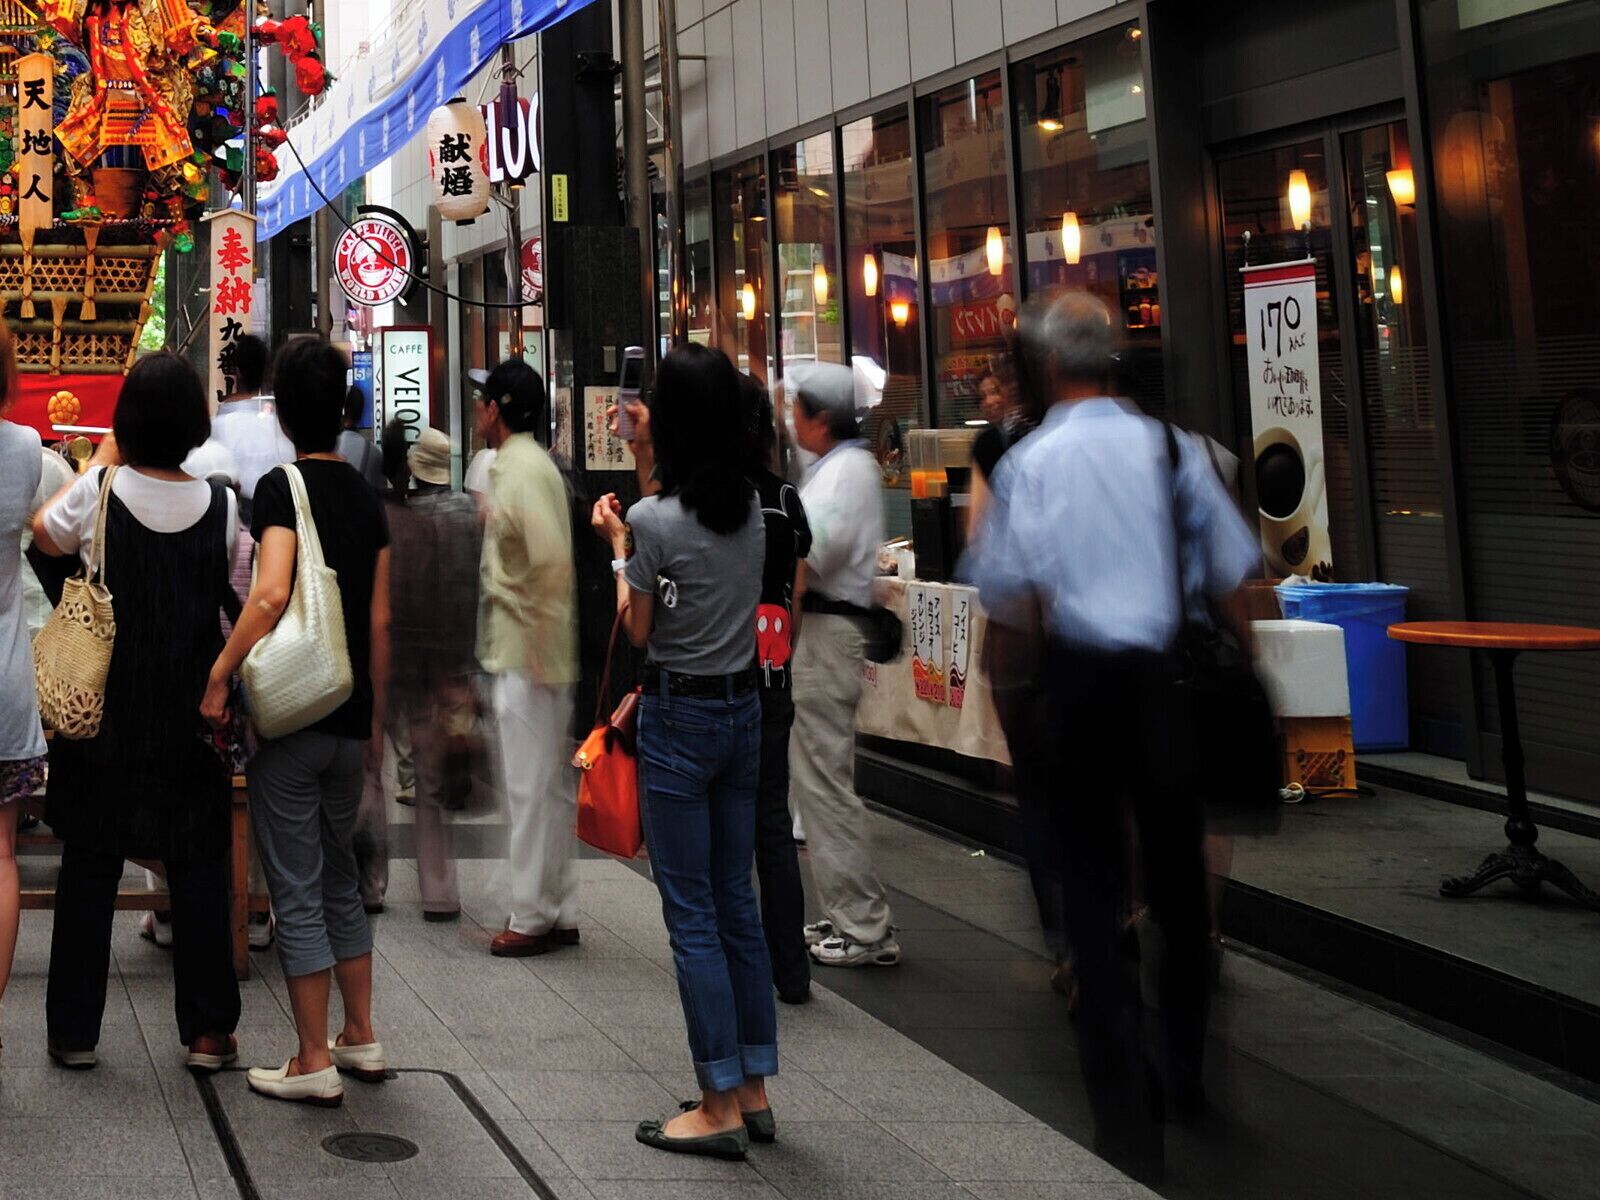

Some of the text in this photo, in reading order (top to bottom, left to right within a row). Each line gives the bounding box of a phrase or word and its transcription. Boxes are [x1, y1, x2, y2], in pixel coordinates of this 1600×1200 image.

[21, 78, 52, 203] 天地人
[439, 134, 474, 197] 献燈
[340, 268, 375, 300] WORLD
[1260, 296, 1300, 358] 170
